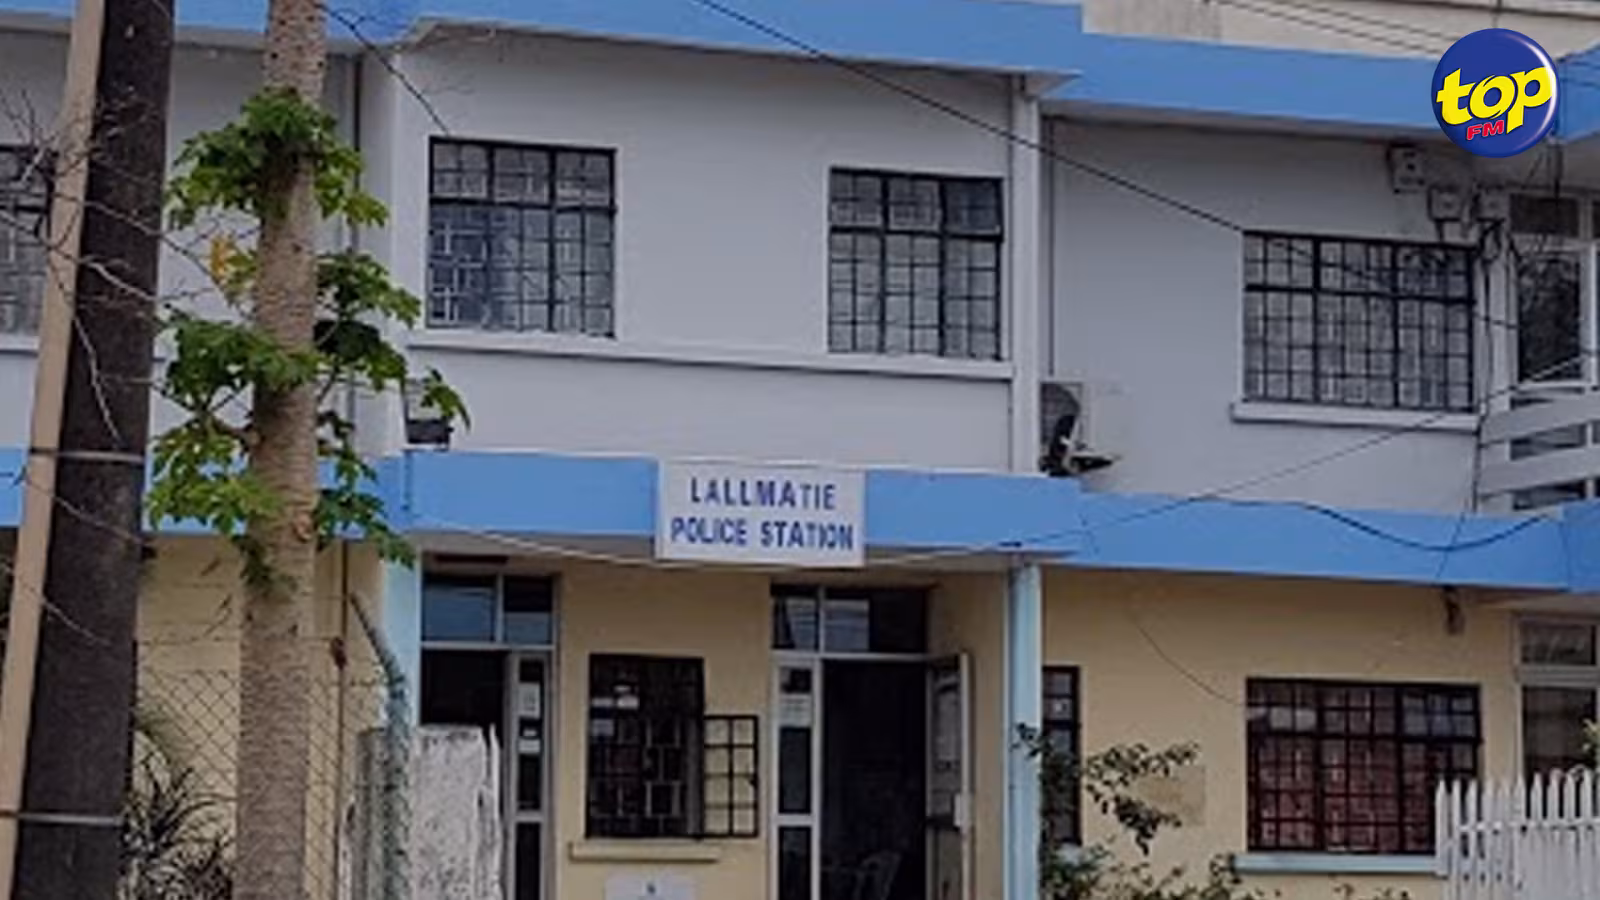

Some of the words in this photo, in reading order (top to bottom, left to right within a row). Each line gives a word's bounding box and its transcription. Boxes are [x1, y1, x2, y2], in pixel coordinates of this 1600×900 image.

[690, 476, 837, 511] LALLMATIE
[671, 516, 748, 546] POLICE
[760, 520, 854, 551] STATION
